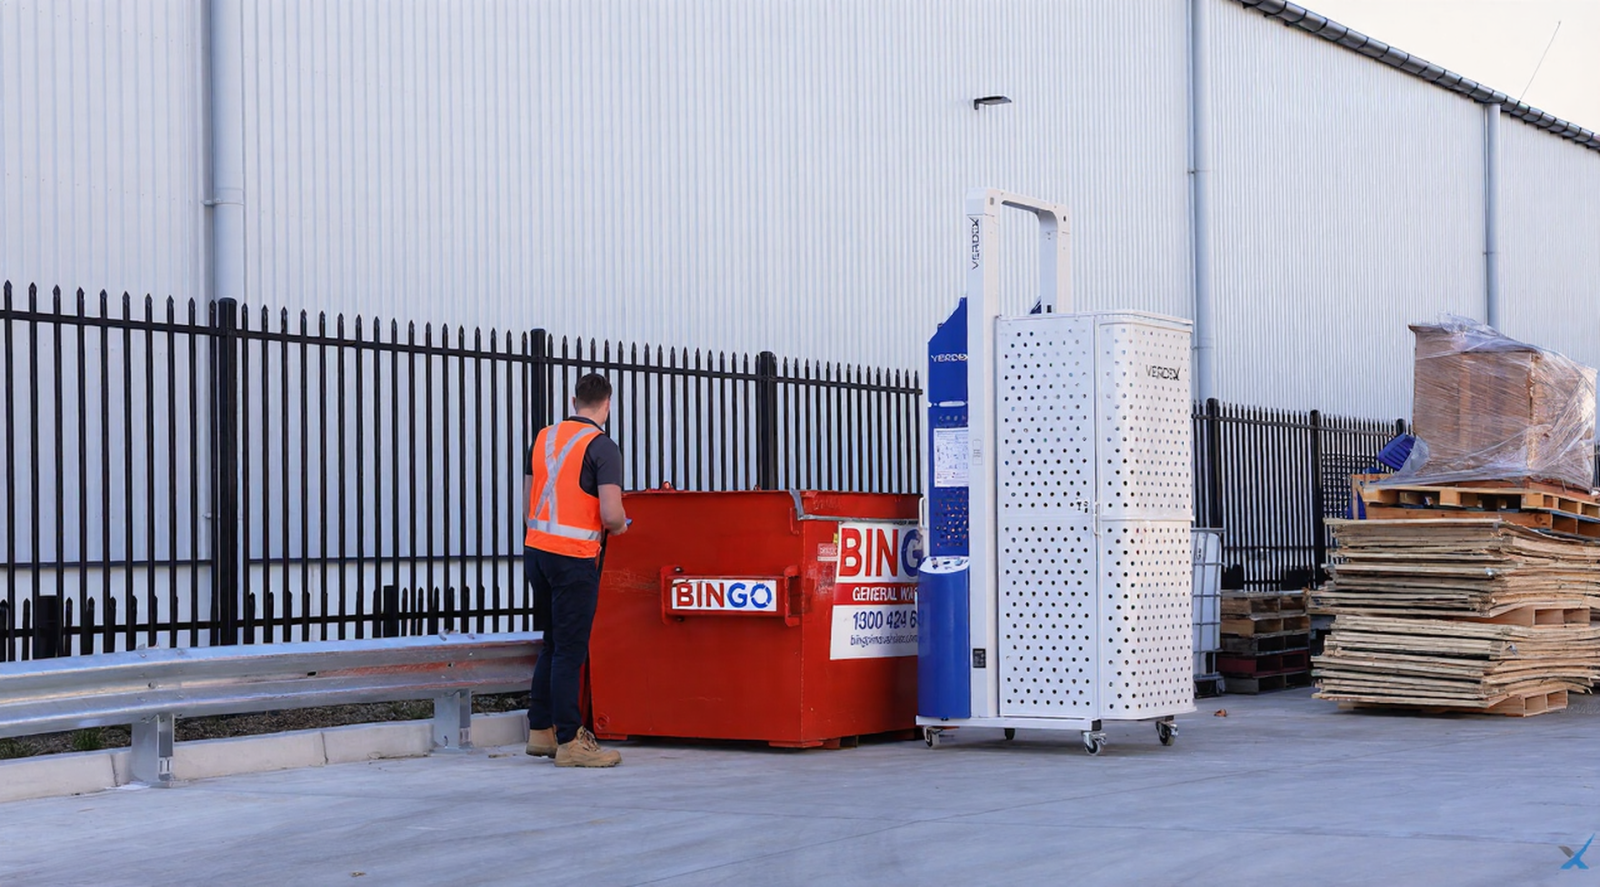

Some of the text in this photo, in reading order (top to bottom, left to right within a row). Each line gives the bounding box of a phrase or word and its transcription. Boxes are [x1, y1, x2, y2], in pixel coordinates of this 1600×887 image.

[969, 217, 980, 270] VERDEX
[1145, 364, 1181, 381] VERDEX
[676, 582, 772, 609] BINGO
[852, 586, 898, 601] GENERAL
[853, 610, 883, 630] 1300
[886, 610, 907, 629] 424
